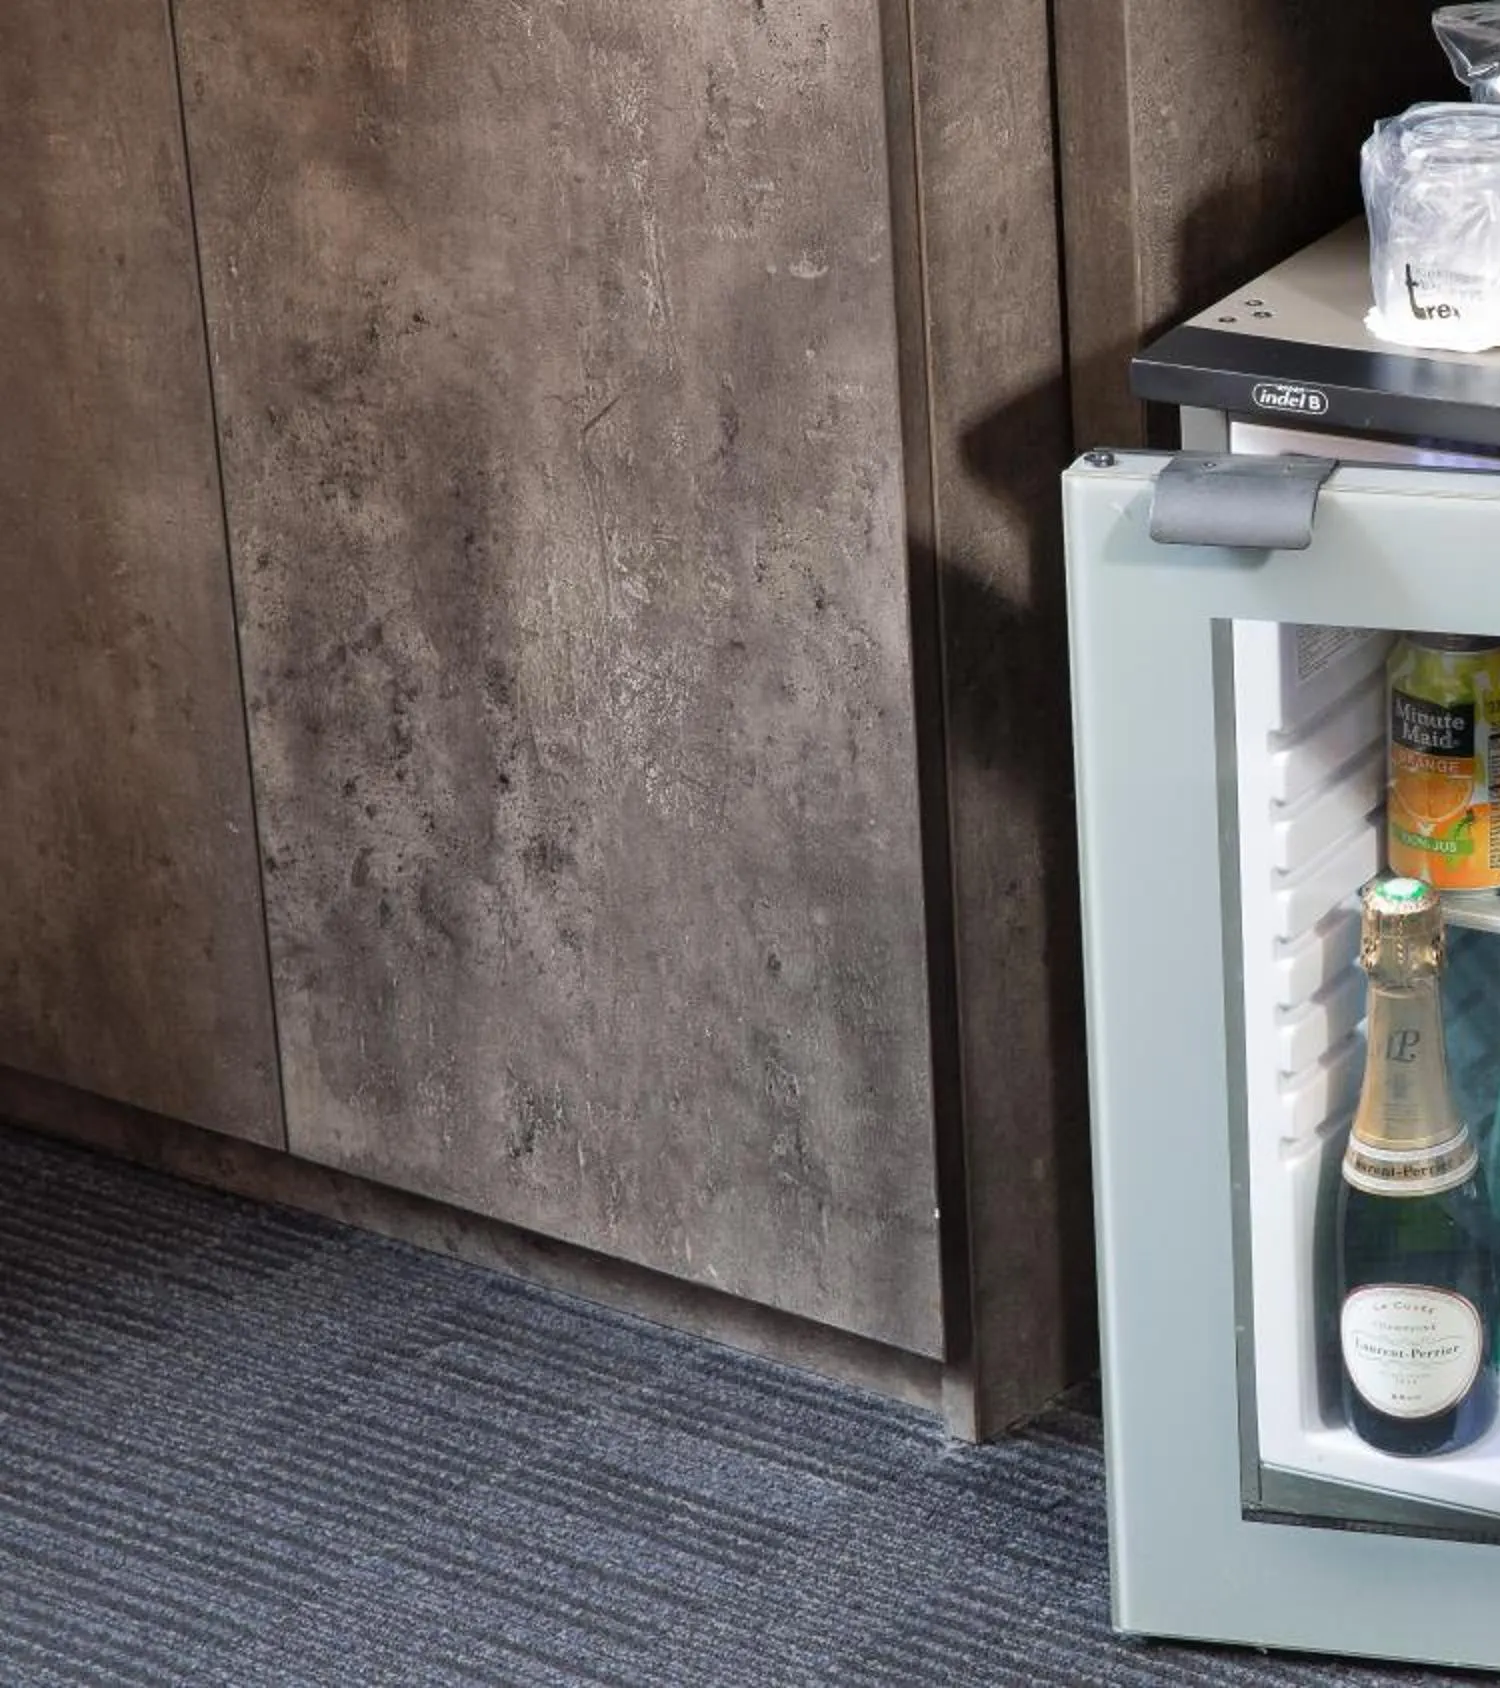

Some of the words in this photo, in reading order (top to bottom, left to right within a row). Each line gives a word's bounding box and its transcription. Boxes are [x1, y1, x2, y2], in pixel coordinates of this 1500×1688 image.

[1260, 388, 1306, 409] indel
[1309, 395, 1321, 411] B
[1397, 698, 1466, 731] Minute
[1402, 722, 1454, 749] Maid
